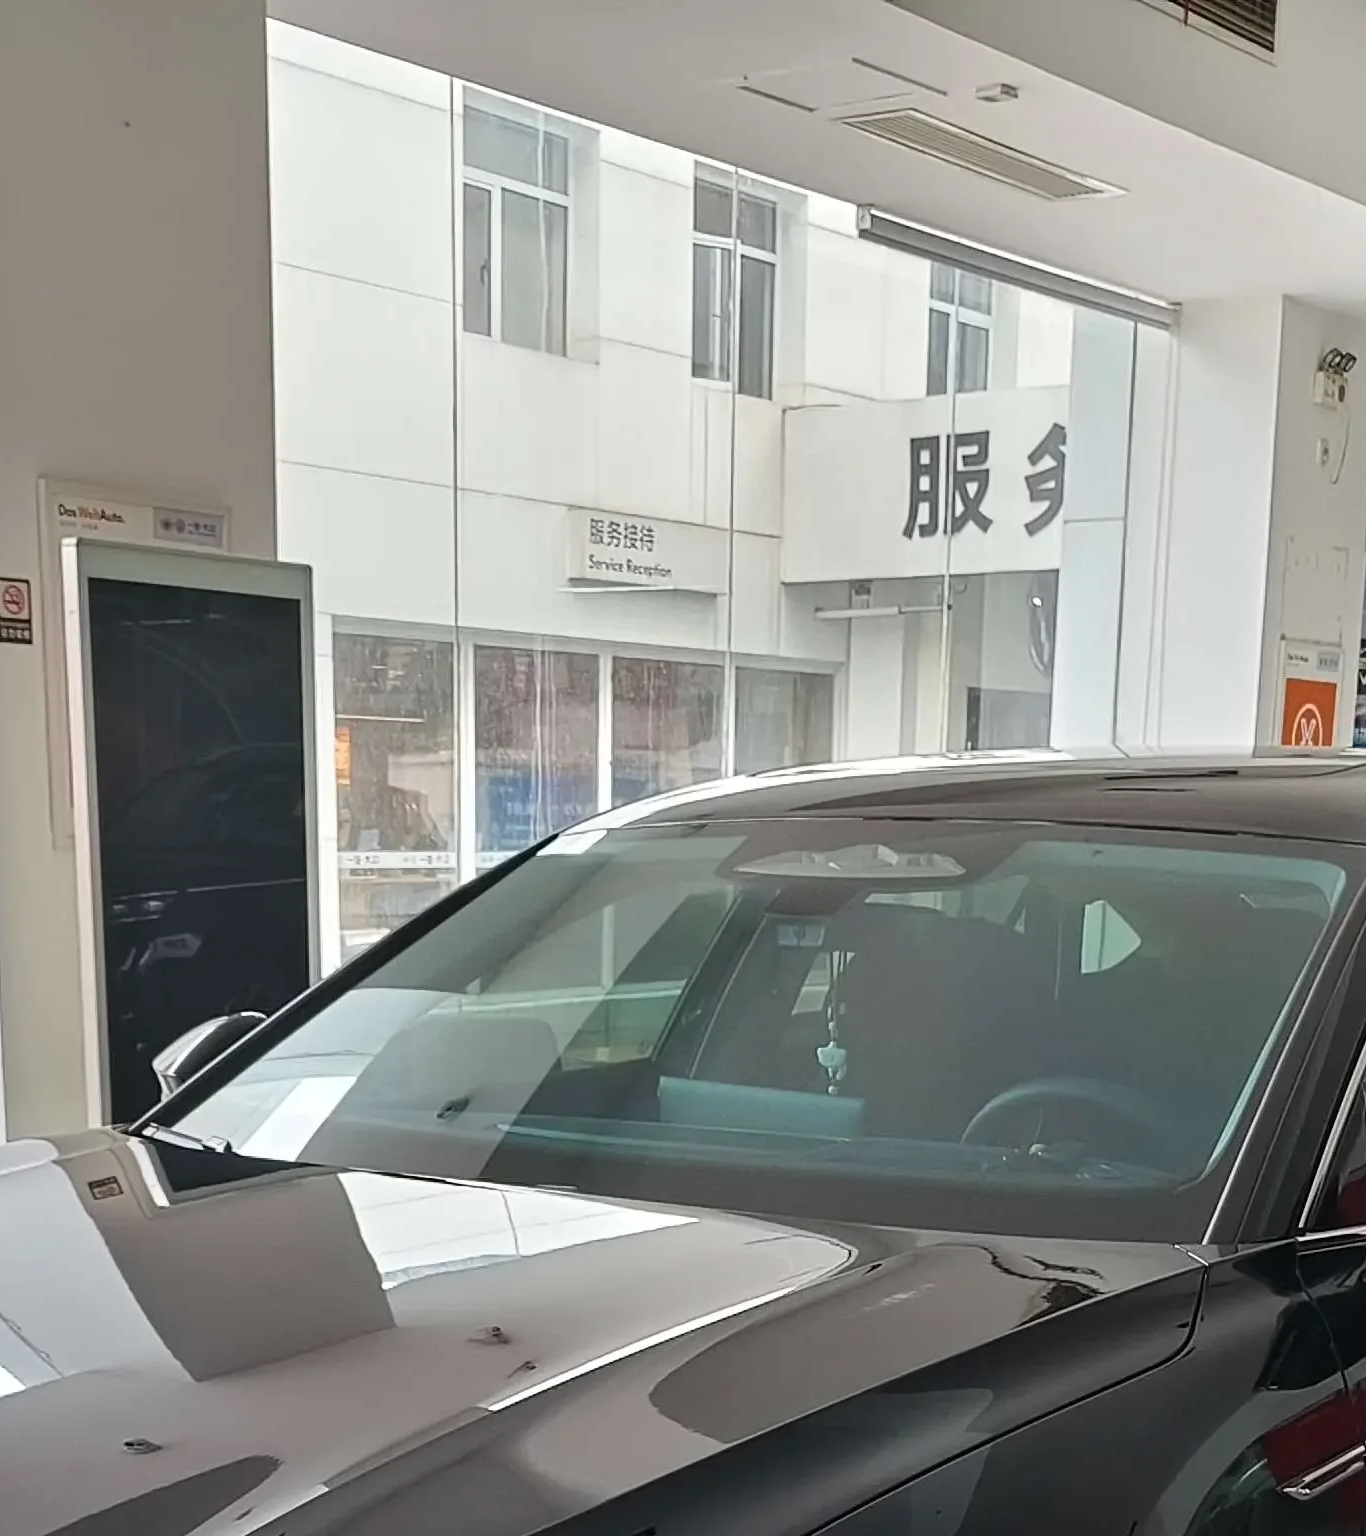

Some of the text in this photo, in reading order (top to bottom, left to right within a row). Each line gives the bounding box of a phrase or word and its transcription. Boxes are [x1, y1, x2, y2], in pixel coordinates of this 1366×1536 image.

[589, 518, 655, 552] 服务接待
[588, 553, 672, 578] Service Reception
